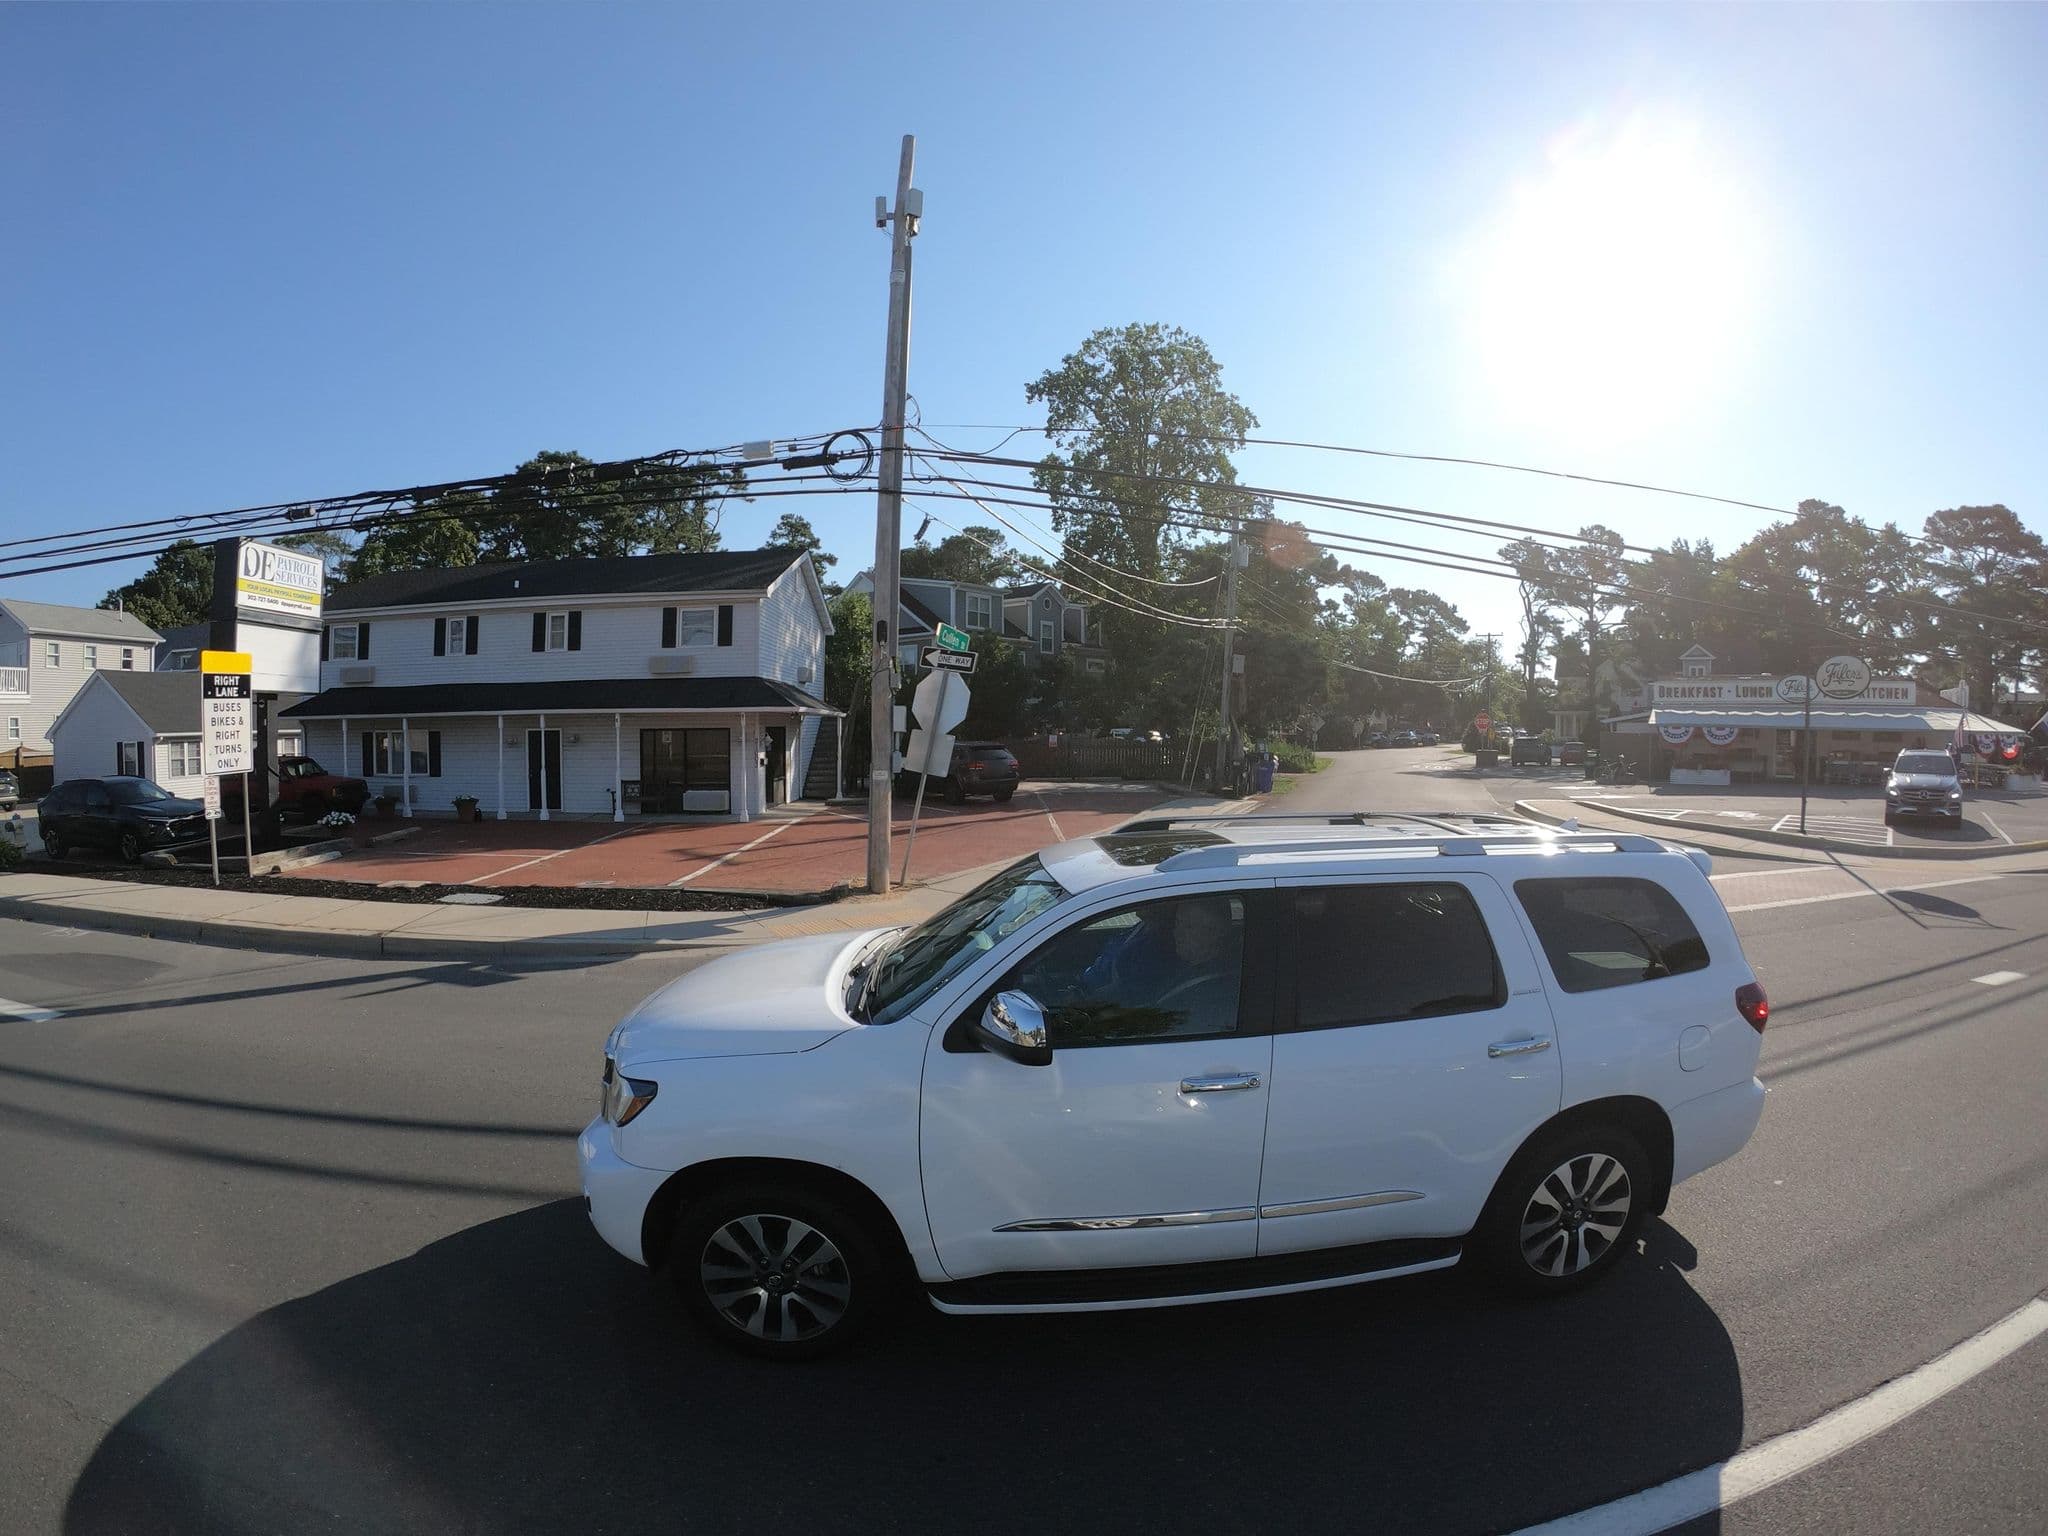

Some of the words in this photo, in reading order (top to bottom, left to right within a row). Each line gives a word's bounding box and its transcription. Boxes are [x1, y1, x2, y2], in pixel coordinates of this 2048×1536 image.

[277, 557, 318, 577] PAYROLL
[275, 570, 318, 588] SERVICES
[937, 654, 953, 664] ONE
[955, 656, 970, 665] WAY
[214, 675, 240, 686] RIGHT
[215, 687, 239, 697] LANE
[1658, 685, 1723, 698] BREAKFAST
[1735, 684, 1773, 698] LUNCH
[213, 703, 242, 712] BUSES
[211, 717, 236, 727] BIKES
[238, 717, 244, 726] &
[215, 730, 240, 741] RIGHT
[214, 744, 242, 755] TURNS
[217, 757, 240, 769] ONLY
